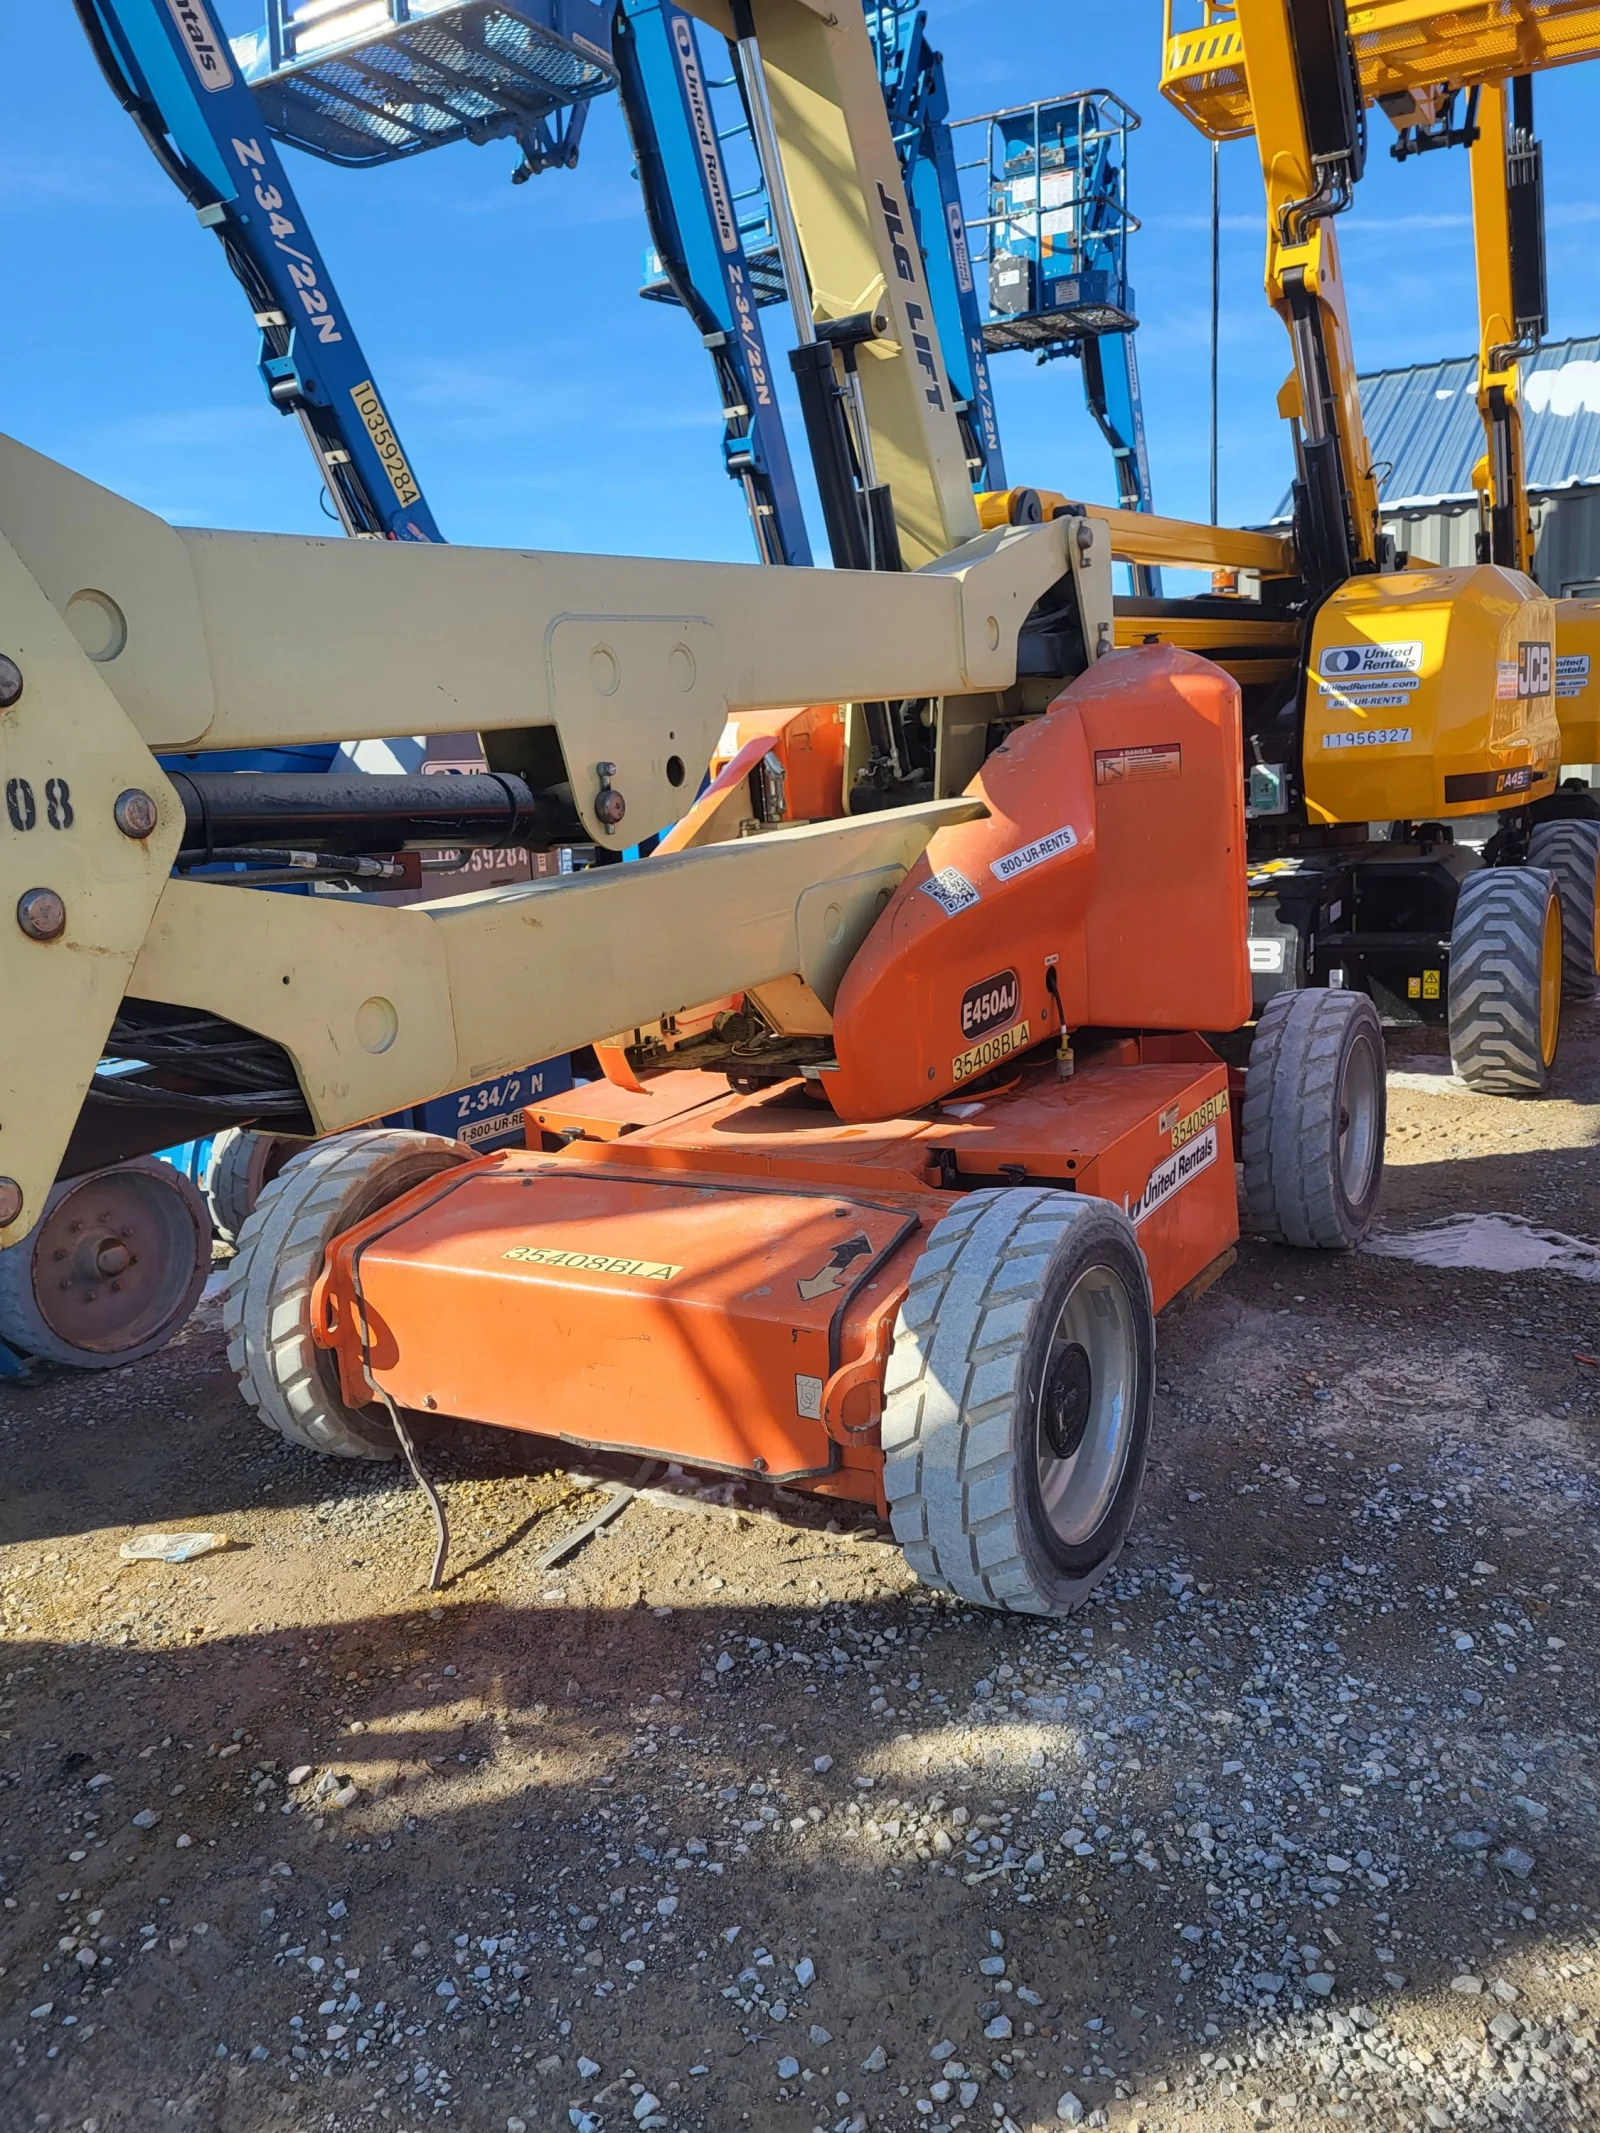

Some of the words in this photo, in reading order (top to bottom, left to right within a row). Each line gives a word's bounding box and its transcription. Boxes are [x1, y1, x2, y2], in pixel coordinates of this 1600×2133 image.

[685, 64, 711, 146] United
[705, 153, 730, 240] Rentals
[231, 138, 342, 345] Z-34/22N
[875, 178, 914, 284] JLG
[906, 301, 946, 413] LIFT
[727, 264, 770, 405] Z-34/22N
[970, 337, 998, 450] Z-34/22N
[1362, 658, 1416, 671] Rentals
[1364, 646, 1414, 659] United
[1519, 646, 1550, 695] JCB
[1321, 680, 1417, 692] UnitedRentals.com
[1125, 748, 1153, 756] DANGER
[1325, 728, 1409, 747] 11956327
[1000, 830, 1073, 875] 800-UR-RENTS
[962, 980, 1018, 1031] E450AJ
[954, 1023, 1030, 1081] 35408BLA
[1172, 1092, 1229, 1148] 35408BLA
[1178, 1136, 1213, 1179] Rentals
[505, 1245, 674, 1281] 35408BLA
